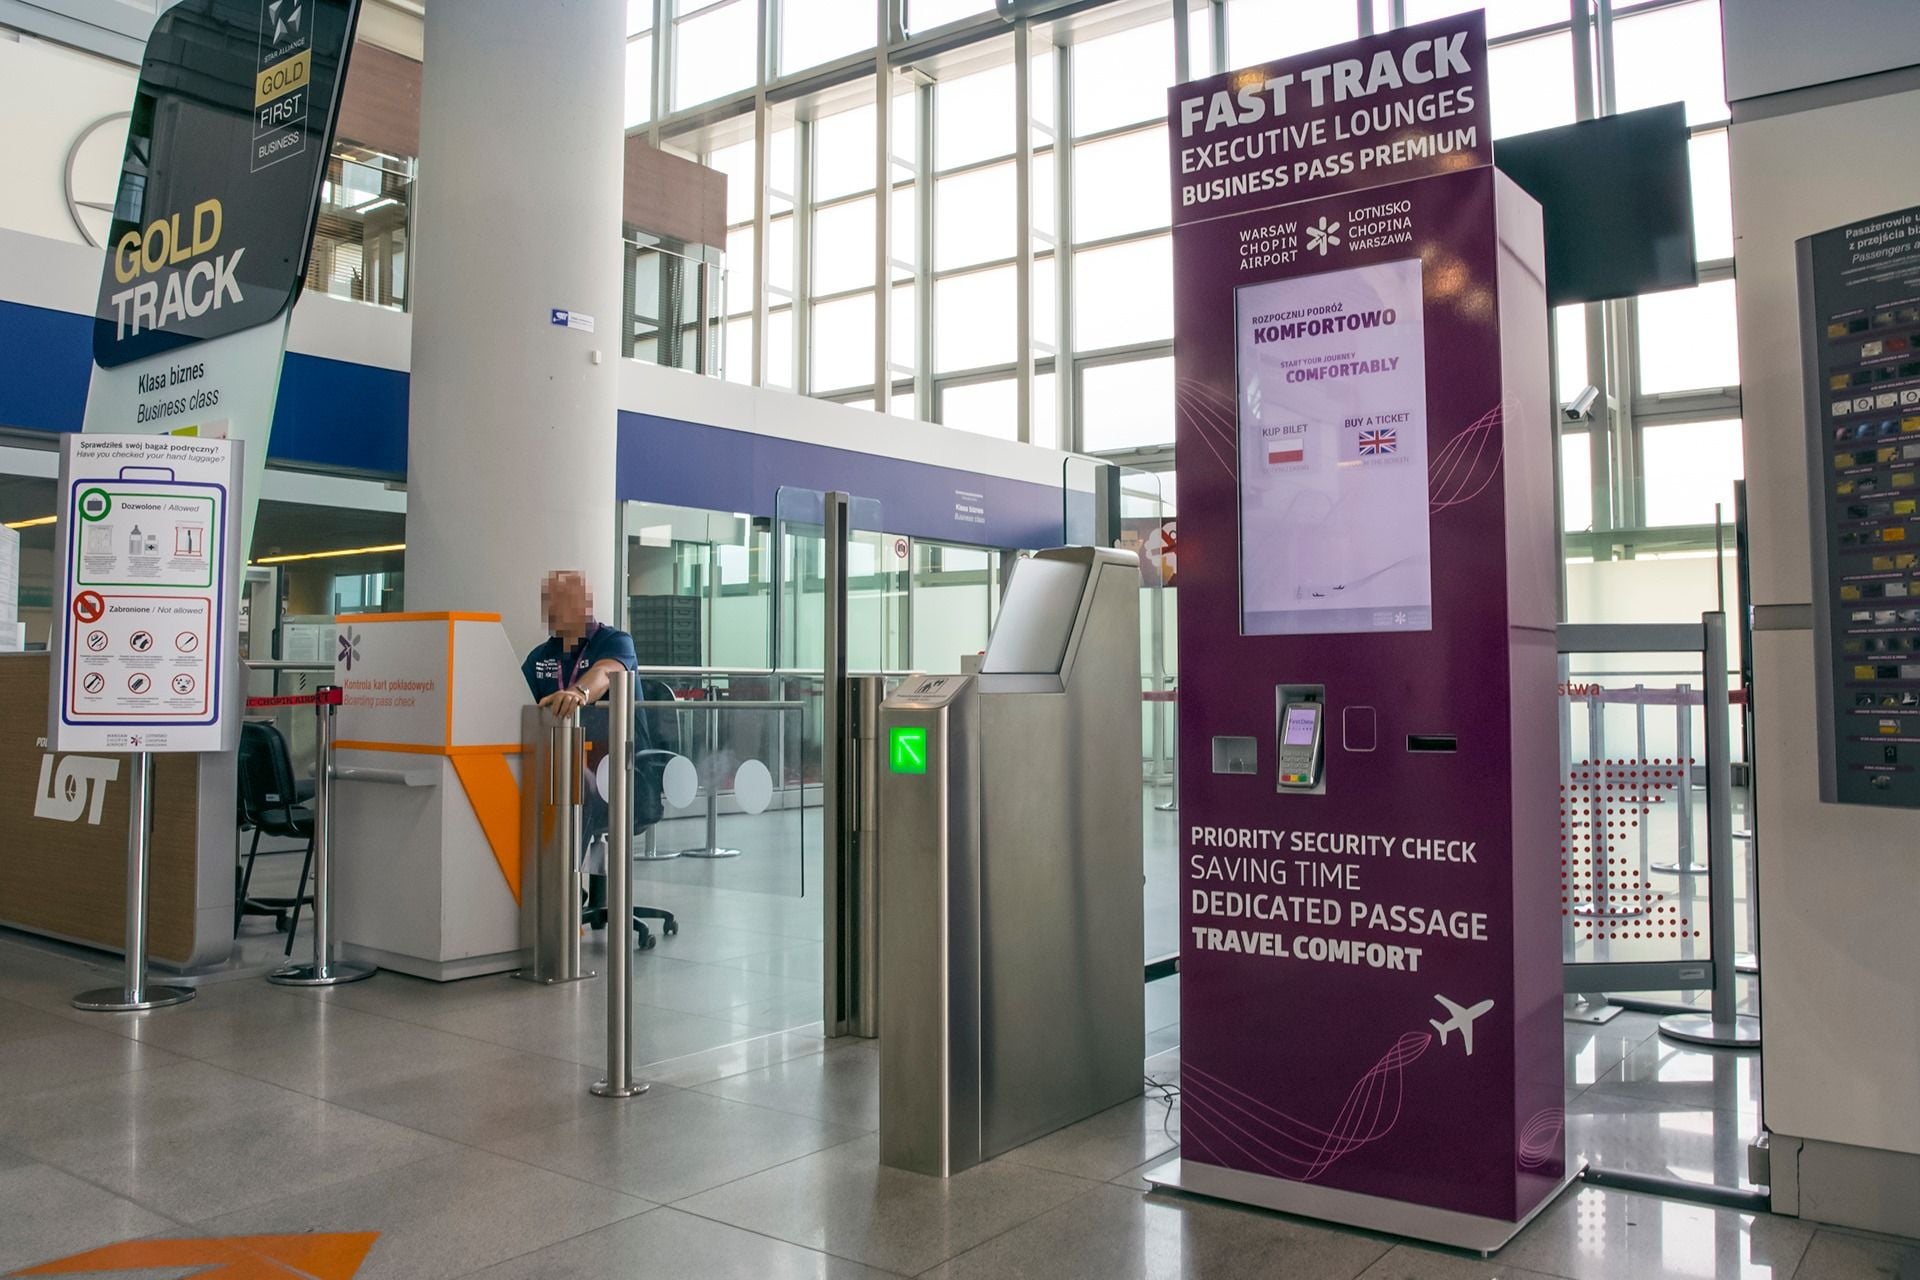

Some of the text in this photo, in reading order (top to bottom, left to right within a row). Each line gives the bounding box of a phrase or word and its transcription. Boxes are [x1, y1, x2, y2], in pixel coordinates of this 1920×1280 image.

[264, 36, 305, 63] STAR ALLIANCE
[262, 61, 304, 95] GOLD
[1180, 31, 1471, 138] FAST TRACK
[260, 93, 302, 129] FIRST
[1181, 85, 1475, 175] EXECUTIVE LOUNGES
[258, 131, 299, 158] BUSINESS
[1182, 126, 1477, 207] BUSINESS PASS PREMIUM
[1348, 199, 1412, 223] LOTNISKO
[1239, 221, 1298, 242] WARSAW
[1348, 216, 1412, 239] CHOPINA
[1845, 215, 1912, 239] Pasażerowie
[114, 198, 223, 284] GOLD
[1239, 236, 1298, 256] CHOPIN
[1348, 231, 1413, 252] WARSZAWA
[1857, 229, 1905, 250] przejścia
[1239, 250, 1298, 271] AIRPORT
[1852, 242, 1911, 264] Passengers
[111, 247, 246, 342] TRACK
[1252, 302, 1343, 325] ROZPOCZNIJ PODRÓŻ
[1254, 308, 1397, 345] KOMFORTOWO
[1280, 352, 1356, 368] START YOUR JOURNEY
[1286, 356, 1400, 384] COMFORTABLY
[138, 362, 204, 395] Klasa biznes
[137, 388, 219, 423] Business class
[1262, 424, 1308, 438] KUP BILET
[1344, 413, 1411, 428] BUY A TICKET
[80, 441, 219, 454] Sprawdziłeś swój bagaż podręczny?
[96, 452, 111, 460] you
[111, 451, 144, 459] checked
[146, 453, 164, 461] your
[188, 454, 226, 463] luggage?
[121, 502, 162, 511] Dozwolone
[168, 504, 200, 513] Allowed
[109, 605, 150, 614] Zabronione
[157, 606, 172, 614] Not
[173, 607, 203, 615] allowed
[344, 680, 435, 693] Kontrola kart pokładowych
[344, 695, 416, 708] Boarding pass check
[33, 753, 120, 825] LOT
[1191, 826, 1477, 863] PRIORITY SECURITY CHECK
[1190, 854, 1361, 891] SAVING TIME
[1191, 889, 1488, 941] DEDICATED PASSAGE
[1191, 926, 1423, 972] TRAVEL COMFORT
